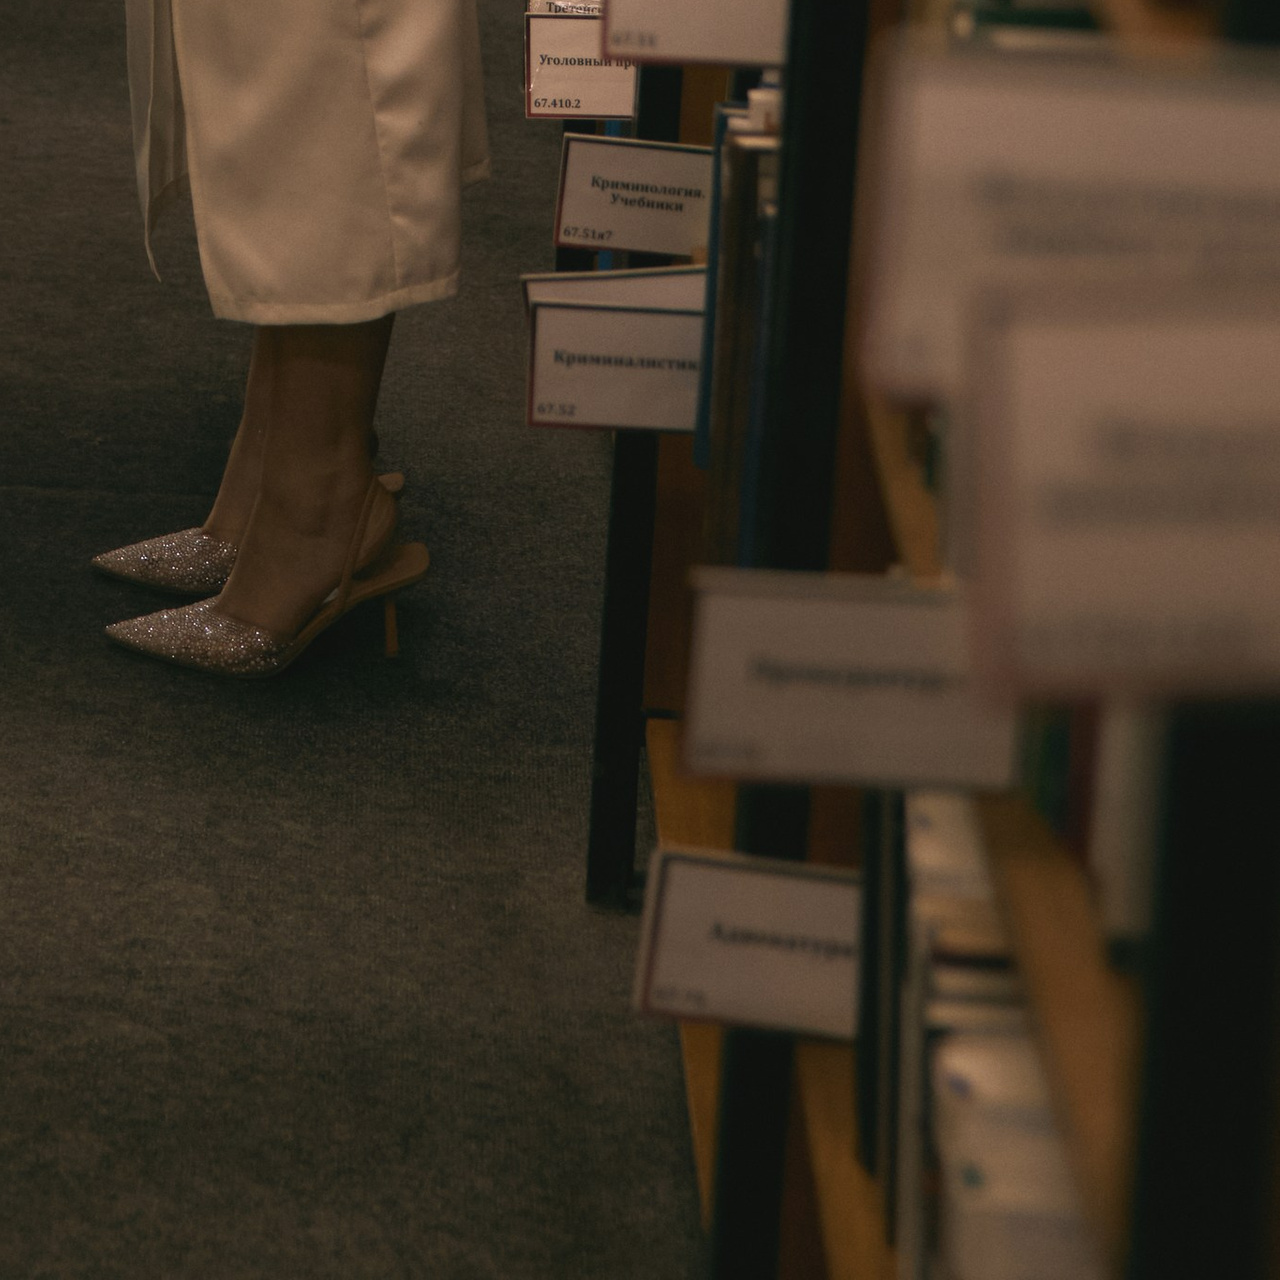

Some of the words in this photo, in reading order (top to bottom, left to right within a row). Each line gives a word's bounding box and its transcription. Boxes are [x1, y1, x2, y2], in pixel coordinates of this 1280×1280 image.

[538, 54, 612, 69] Уголовный
[533, 98, 581, 110] 67.410.2
[590, 174, 705, 200] Криминология.
[610, 192, 685, 213] Учебники
